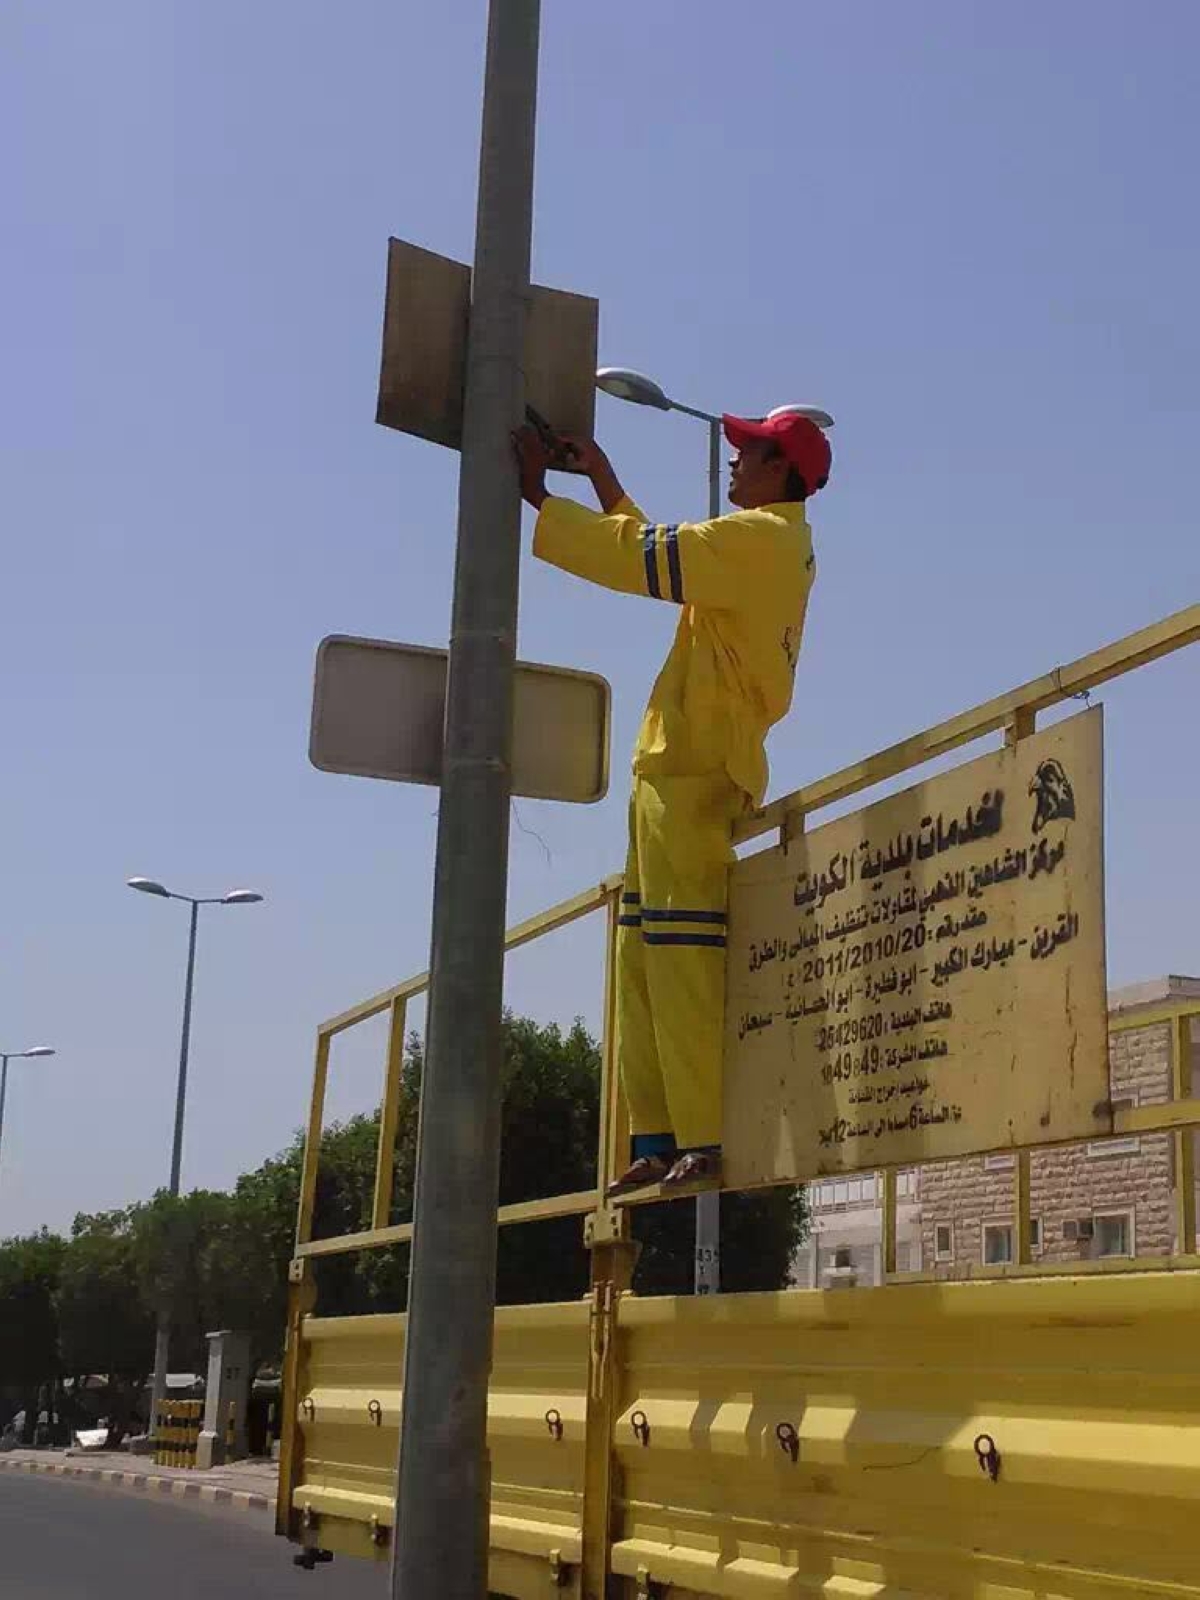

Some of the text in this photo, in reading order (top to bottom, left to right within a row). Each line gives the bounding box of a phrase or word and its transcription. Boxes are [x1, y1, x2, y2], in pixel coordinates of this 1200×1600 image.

[859, 832, 914, 891] بلدية
[1028, 838, 1066, 881] مركز
[794, 850, 856, 916] الكويت
[971, 935, 1015, 971] مبارك
[1030, 911, 1079, 960] القرين
[931, 947, 969, 985] الكبير
